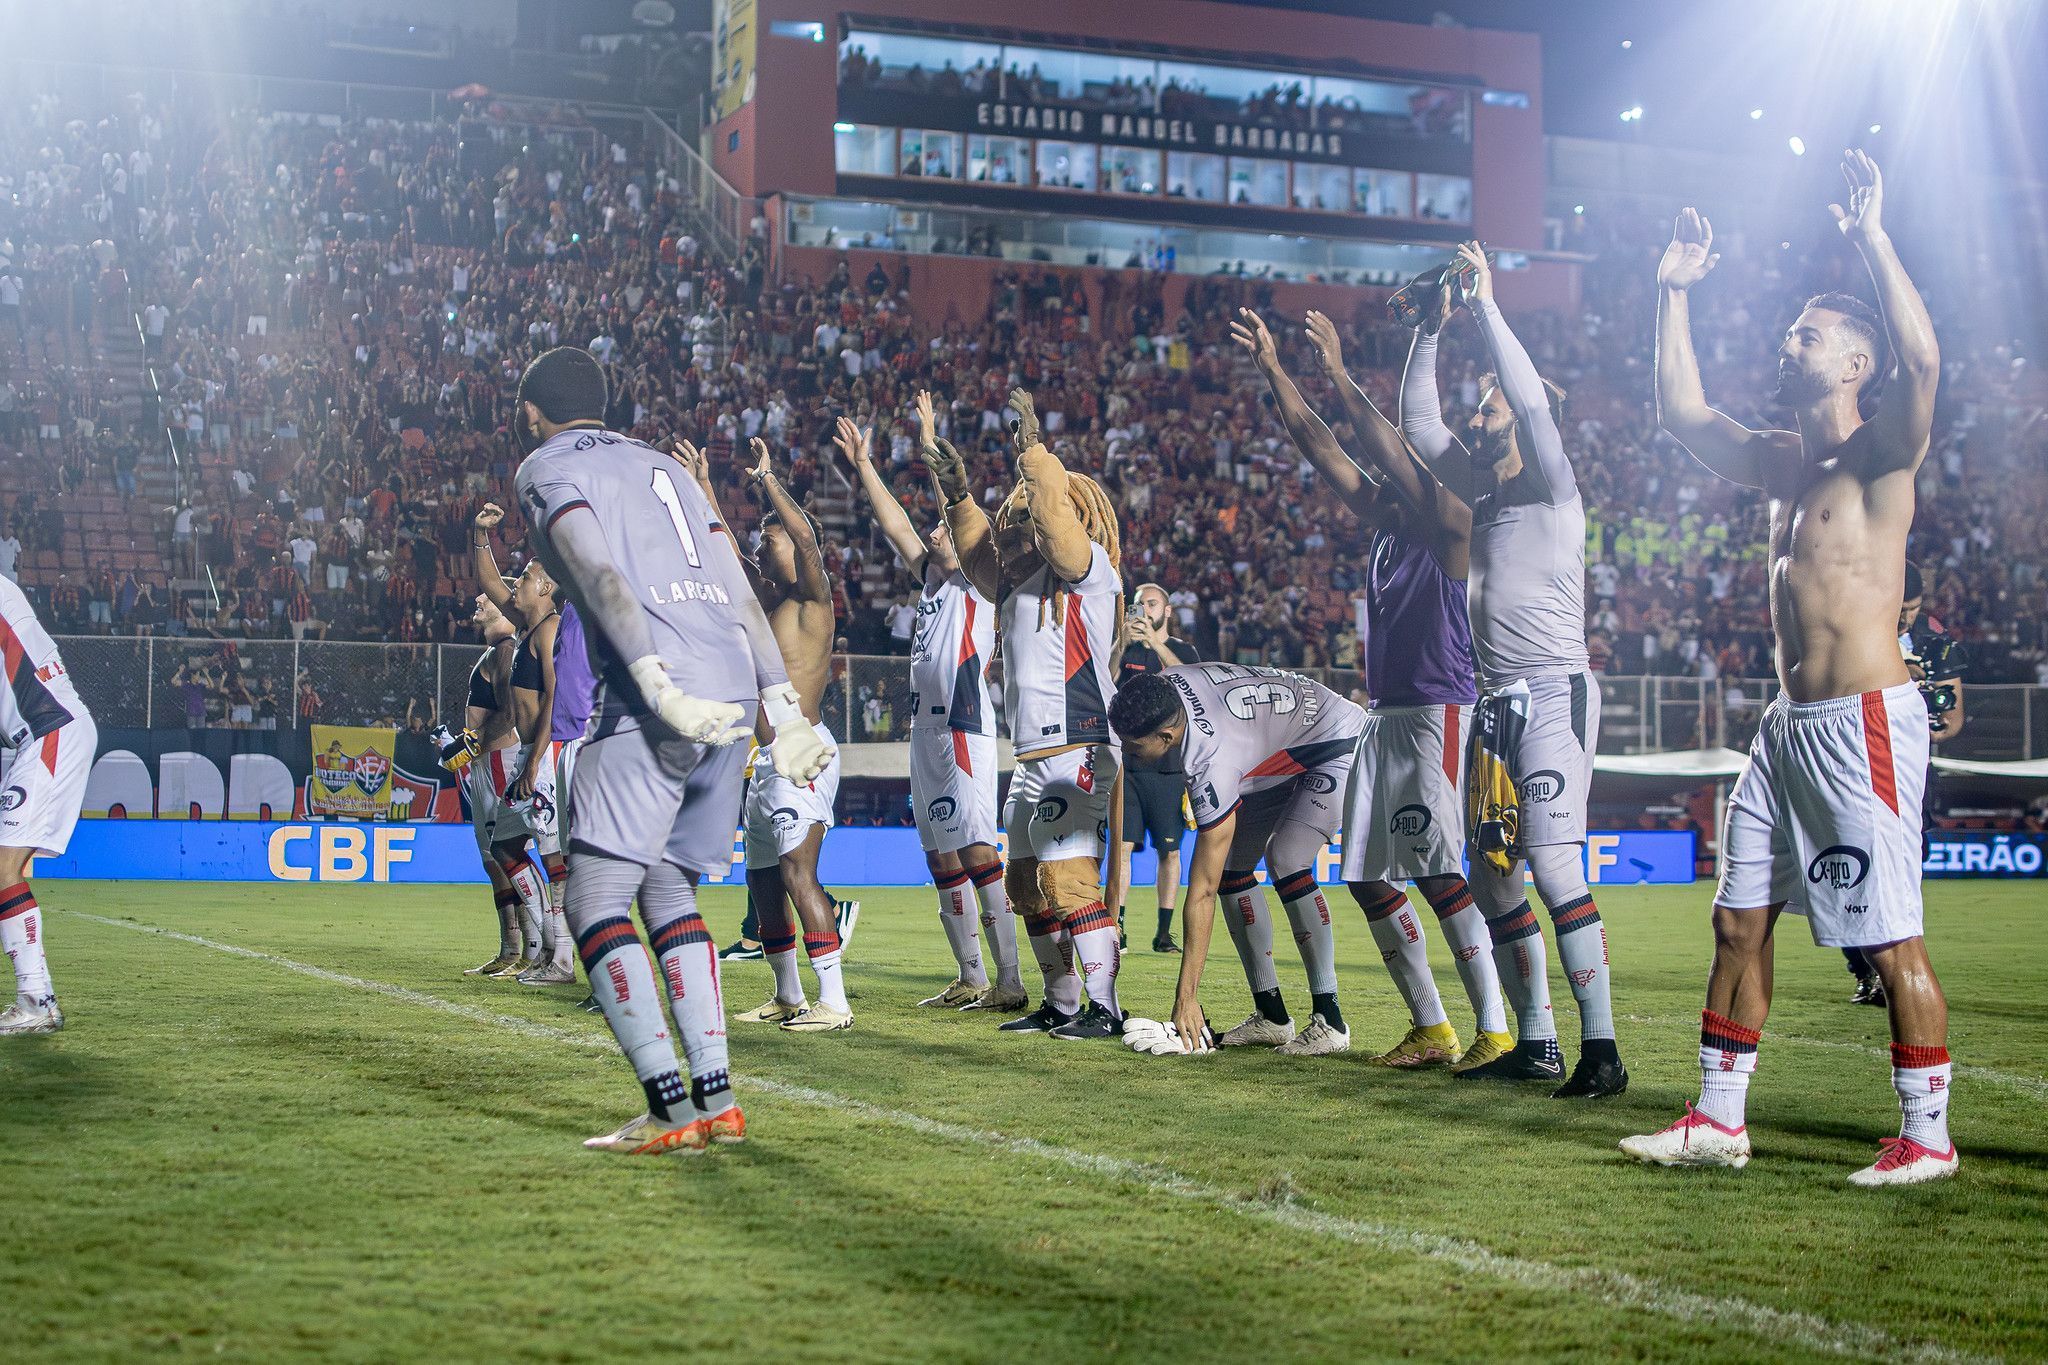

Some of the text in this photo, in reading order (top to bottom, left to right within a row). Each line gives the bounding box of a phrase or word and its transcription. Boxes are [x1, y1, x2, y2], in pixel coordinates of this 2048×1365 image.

[651, 467, 702, 569] 1
[1549, 811, 1570, 819] VOLT
[268, 825, 417, 882] CBF
[1844, 903, 1868, 914] VOLT
